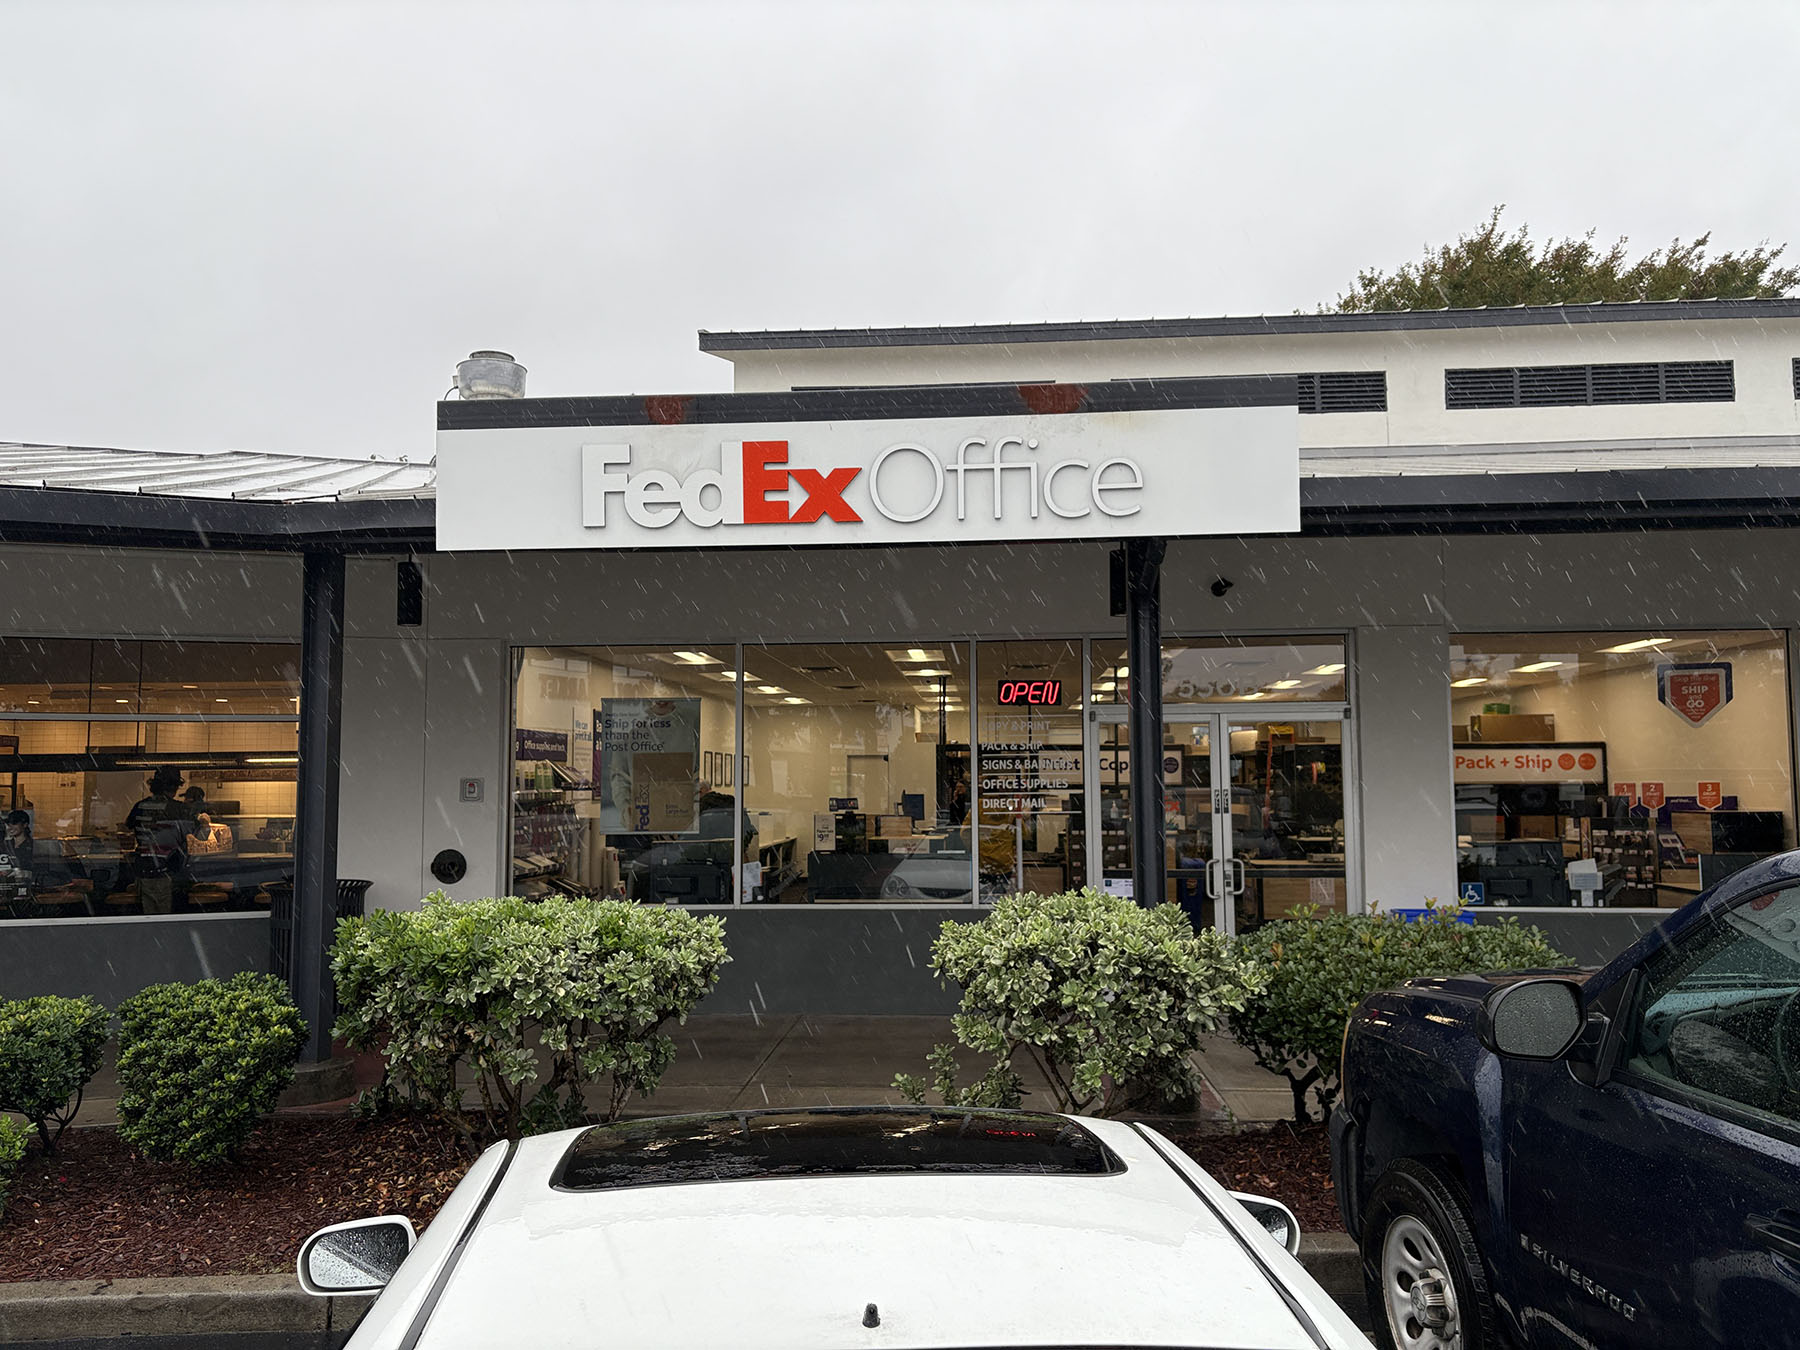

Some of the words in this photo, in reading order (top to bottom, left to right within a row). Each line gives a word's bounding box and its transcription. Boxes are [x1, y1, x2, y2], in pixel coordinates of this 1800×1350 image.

[582, 440, 863, 528] FedEx
[868, 437, 1143, 523] Office
[1000, 681, 1060, 704] OPEN
[1681, 685, 1709, 694] SHIP
[1686, 699, 1705, 708] GO
[604, 719, 629, 730] Ship
[631, 719, 646, 729] for
[650, 719, 671, 729] less
[982, 721, 1009, 731] COPY
[1021, 720, 1052, 731] PRINT
[605, 731, 629, 740] than
[632, 731, 649, 740] the
[605, 742, 629, 752] Post
[981, 741, 1008, 751] PACK
[1010, 741, 1018, 751] &
[1019, 739, 1043, 751] SHIP
[982, 759, 1013, 770] SIGNS
[1014, 759, 1022, 770] &
[1024, 759, 1073, 770] BANNERS
[1455, 755, 1495, 769] Pack
[1514, 755, 1552, 772] Ship
[982, 779, 1019, 790] OFFICE
[1020, 778, 1069, 789] SUPPLIES
[1649, 784, 1656, 792] 2
[634, 784, 650, 832] FedEx
[982, 798, 1020, 809] DIRECT
[1022, 797, 1046, 809] MAIL
[1532, 1242, 1636, 1322] SILVERADO
